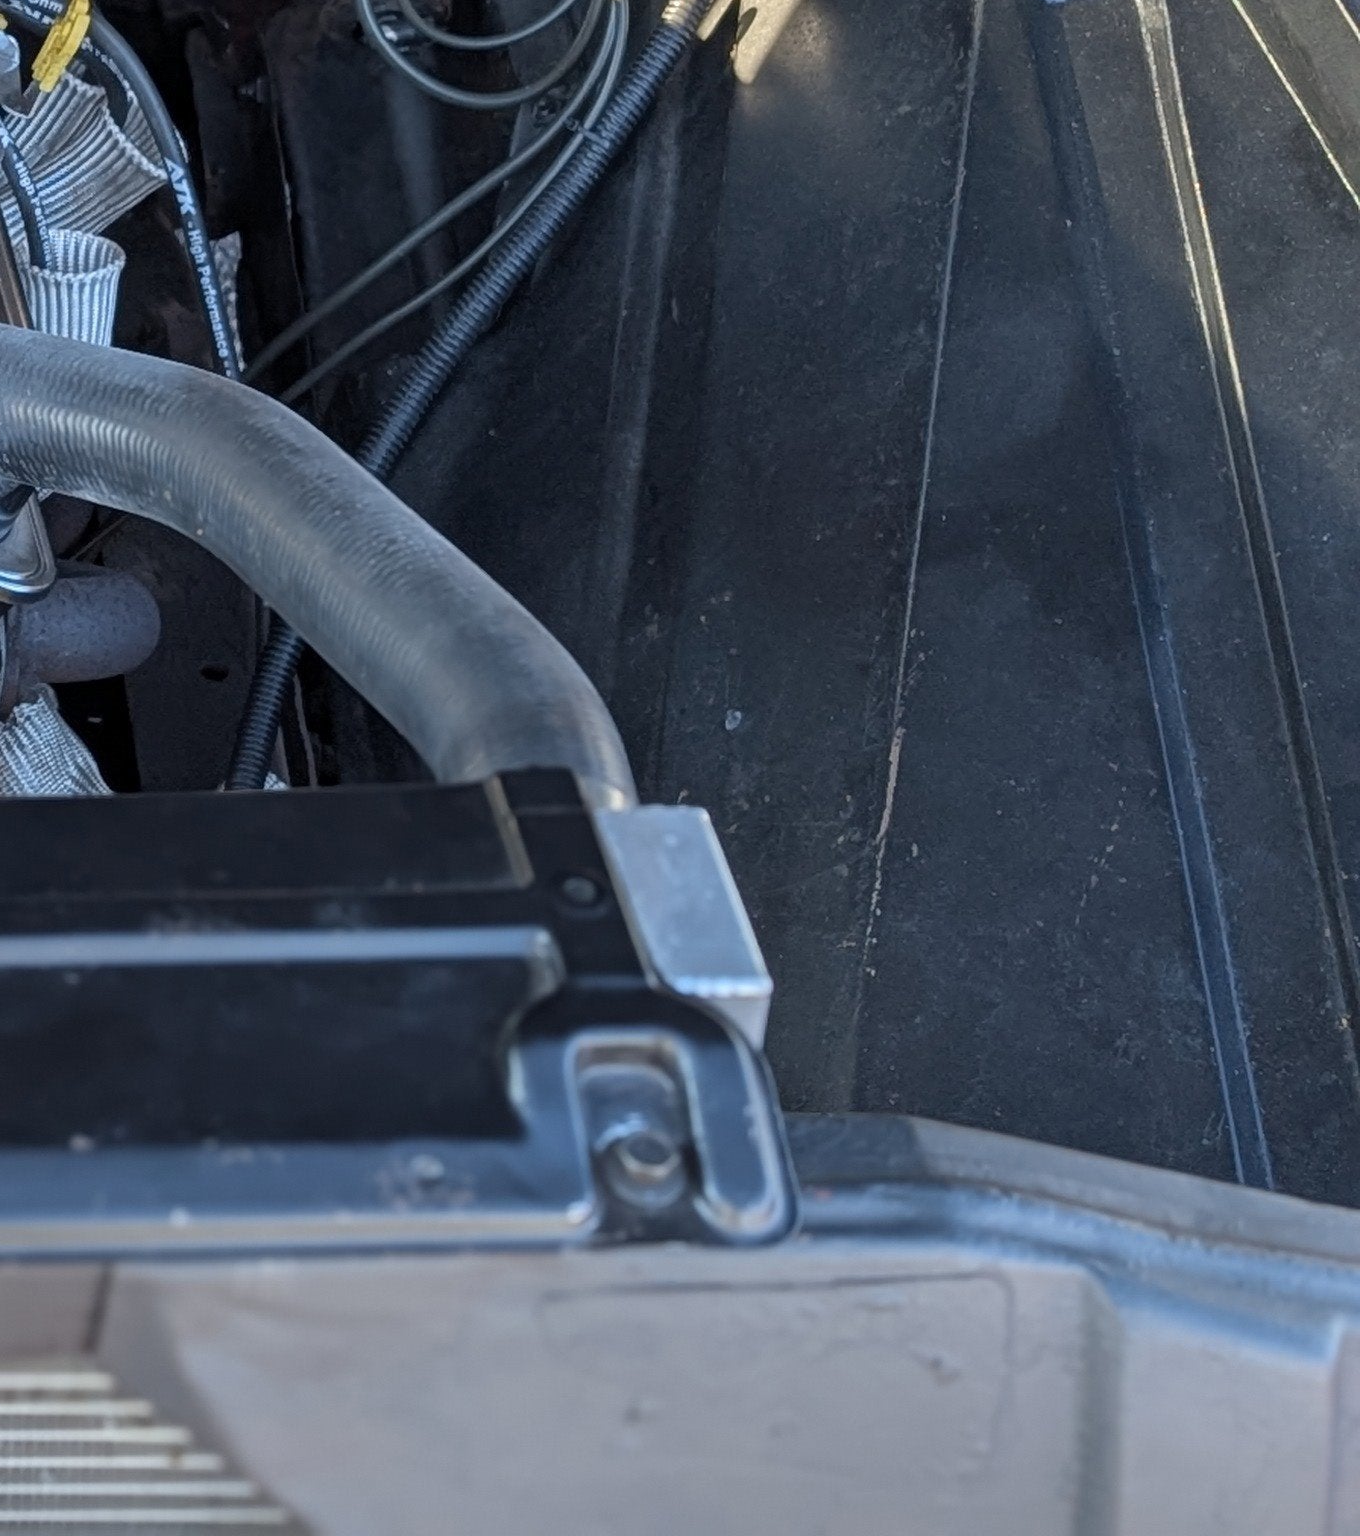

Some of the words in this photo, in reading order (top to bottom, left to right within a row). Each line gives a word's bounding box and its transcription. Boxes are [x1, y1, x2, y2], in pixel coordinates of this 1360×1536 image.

[164, 157, 196, 216] ATK
[189, 229, 208, 262] High
[198, 265, 230, 359] Performance
